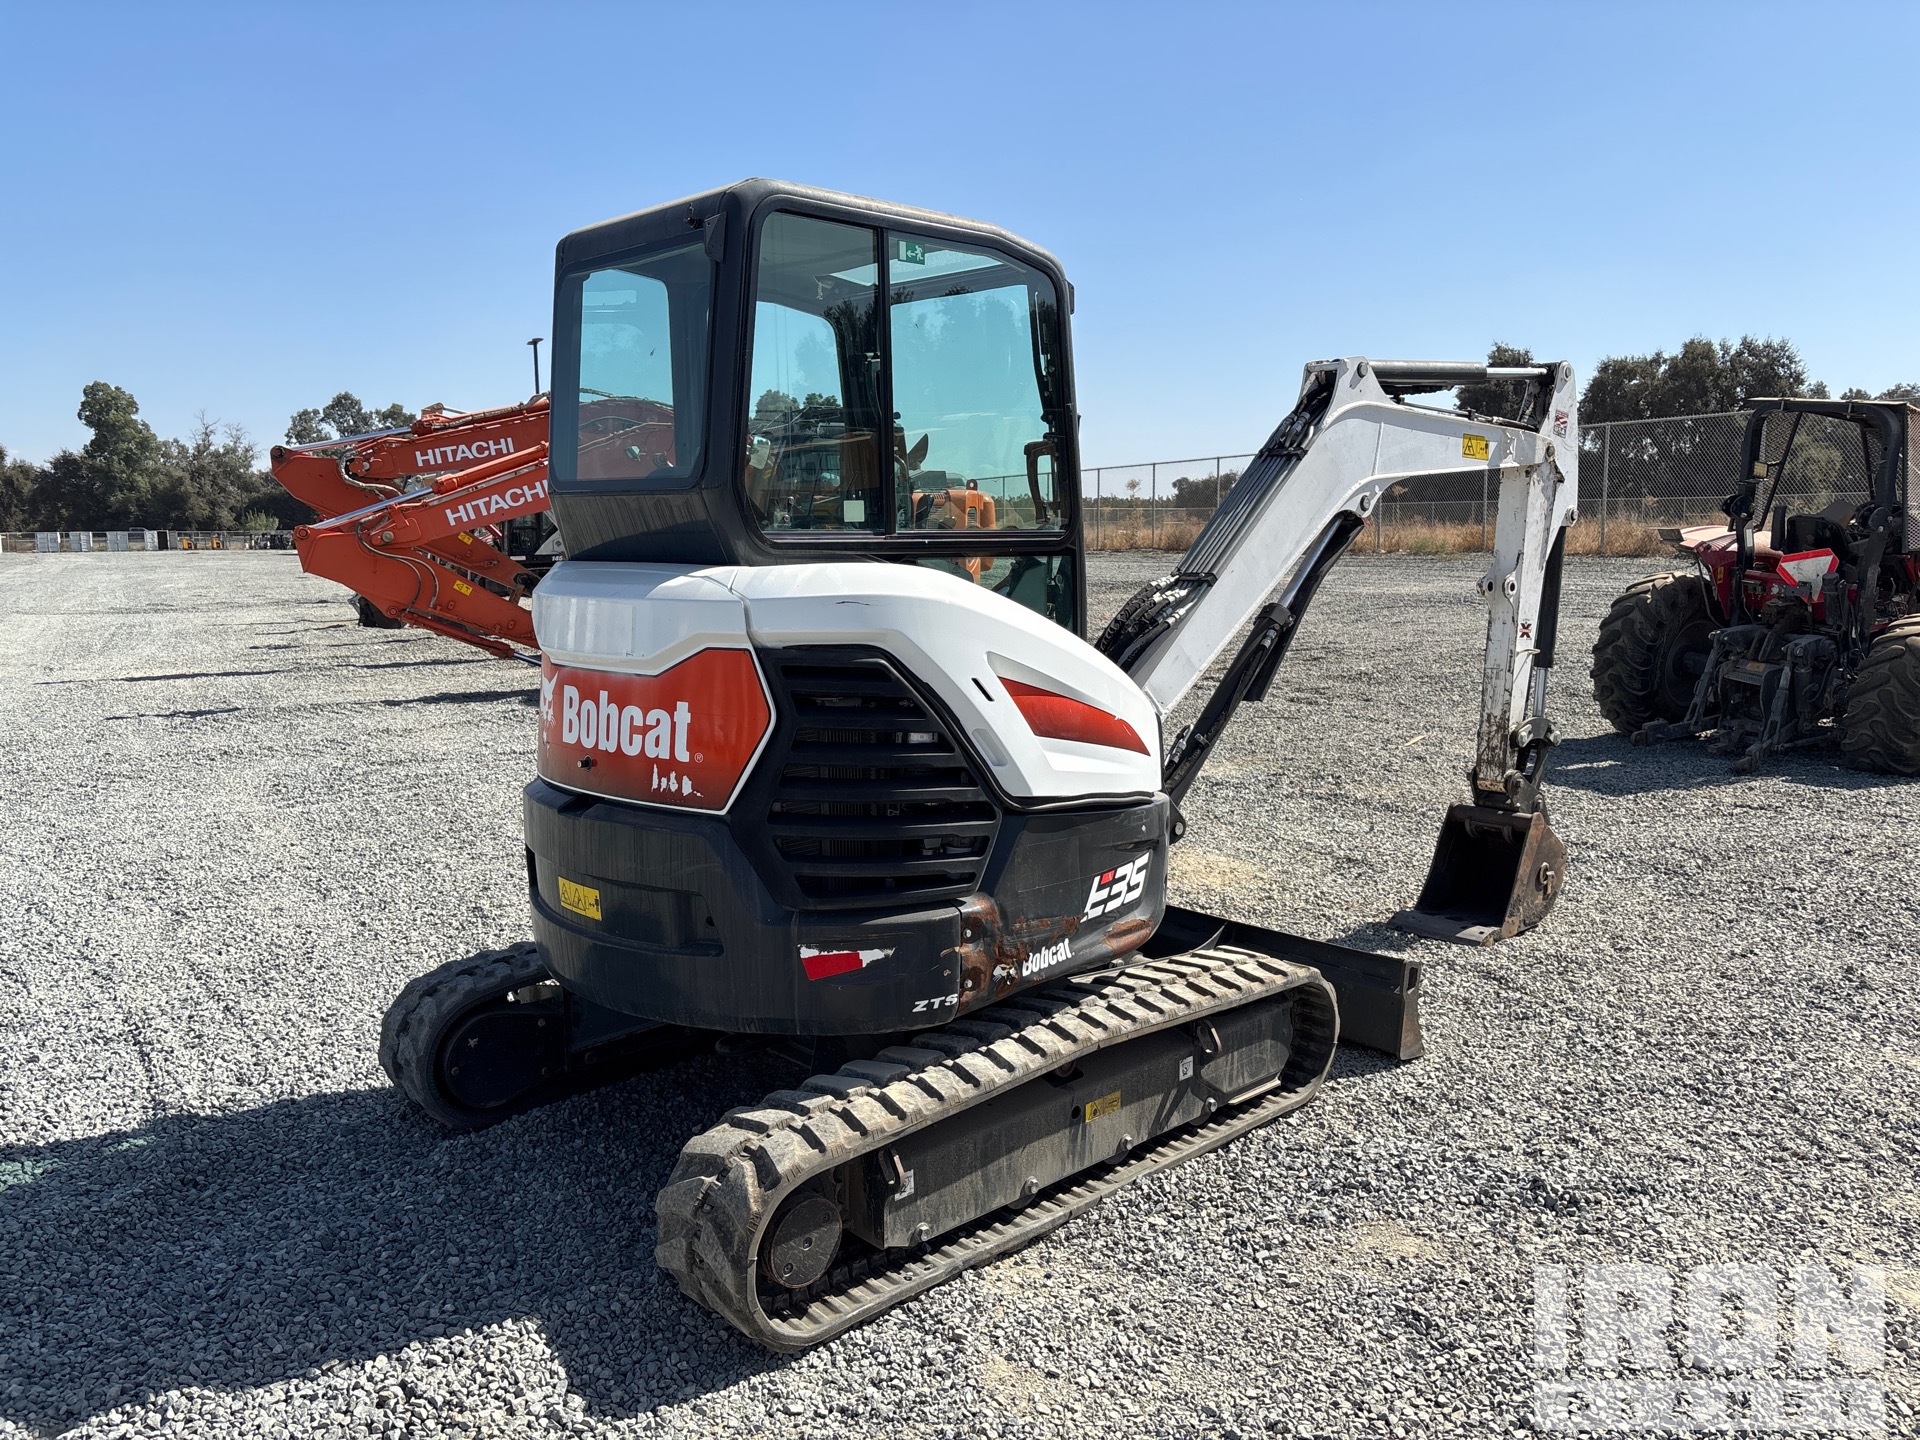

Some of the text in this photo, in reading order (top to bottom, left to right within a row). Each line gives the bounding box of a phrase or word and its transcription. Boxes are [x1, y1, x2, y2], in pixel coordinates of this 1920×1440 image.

[415, 437, 515, 467] HITACHI
[1083, 852, 1150, 923] E35
[1022, 937, 1072, 977] Bobcat
[912, 993, 958, 1013] ZTS
